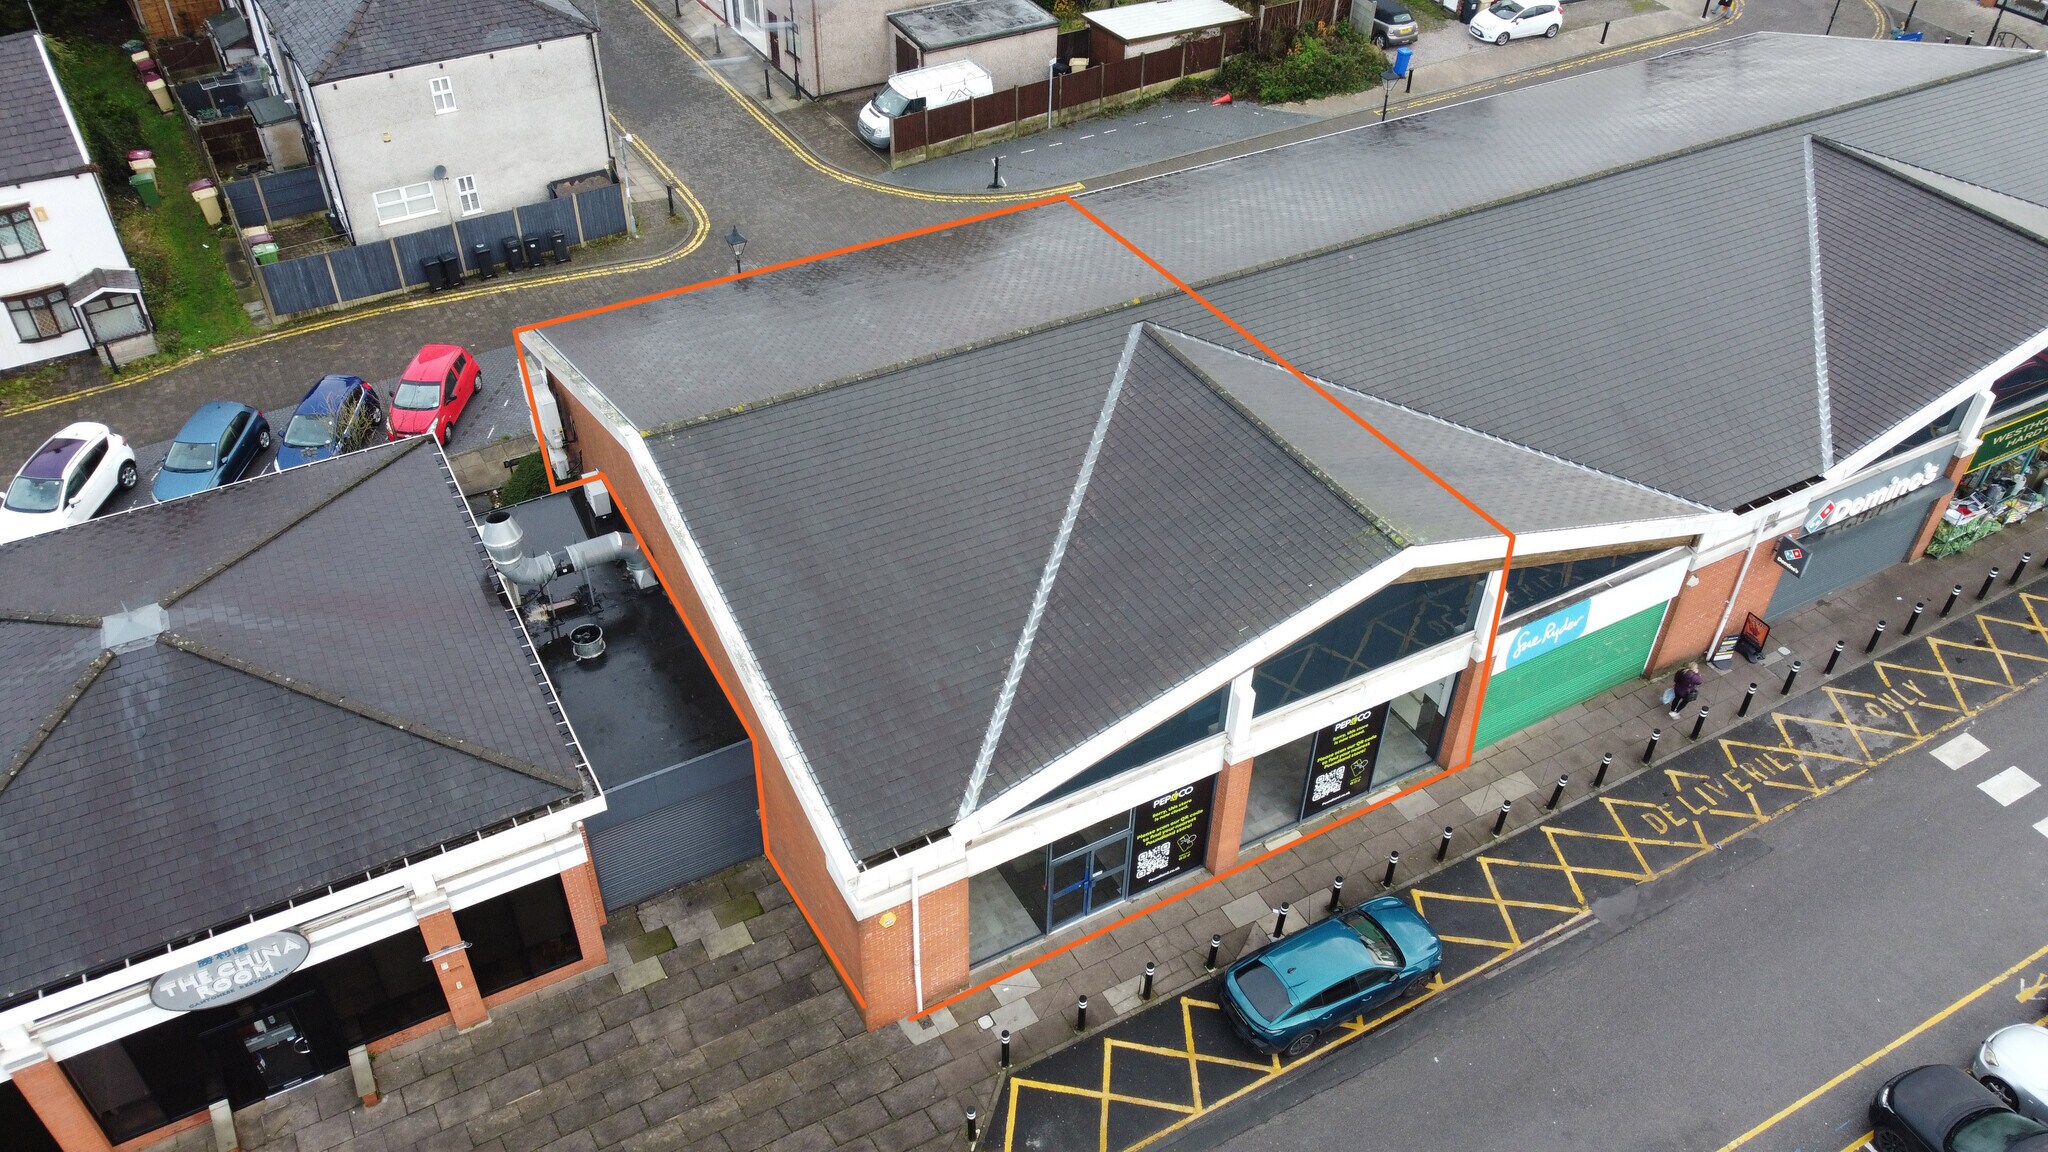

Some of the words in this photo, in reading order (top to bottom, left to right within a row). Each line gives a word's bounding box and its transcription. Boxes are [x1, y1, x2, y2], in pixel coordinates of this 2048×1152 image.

[1828, 462, 1940, 525] Domino's
[1513, 630, 1542, 659] Sue
[1541, 615, 1584, 644] Ryder
[1864, 679, 1927, 719] ONLY
[159, 966, 214, 998] THE
[217, 937, 301, 977] CHINA
[195, 960, 274, 1000] ROOM
[239, 967, 289, 990] RESTAURANT
